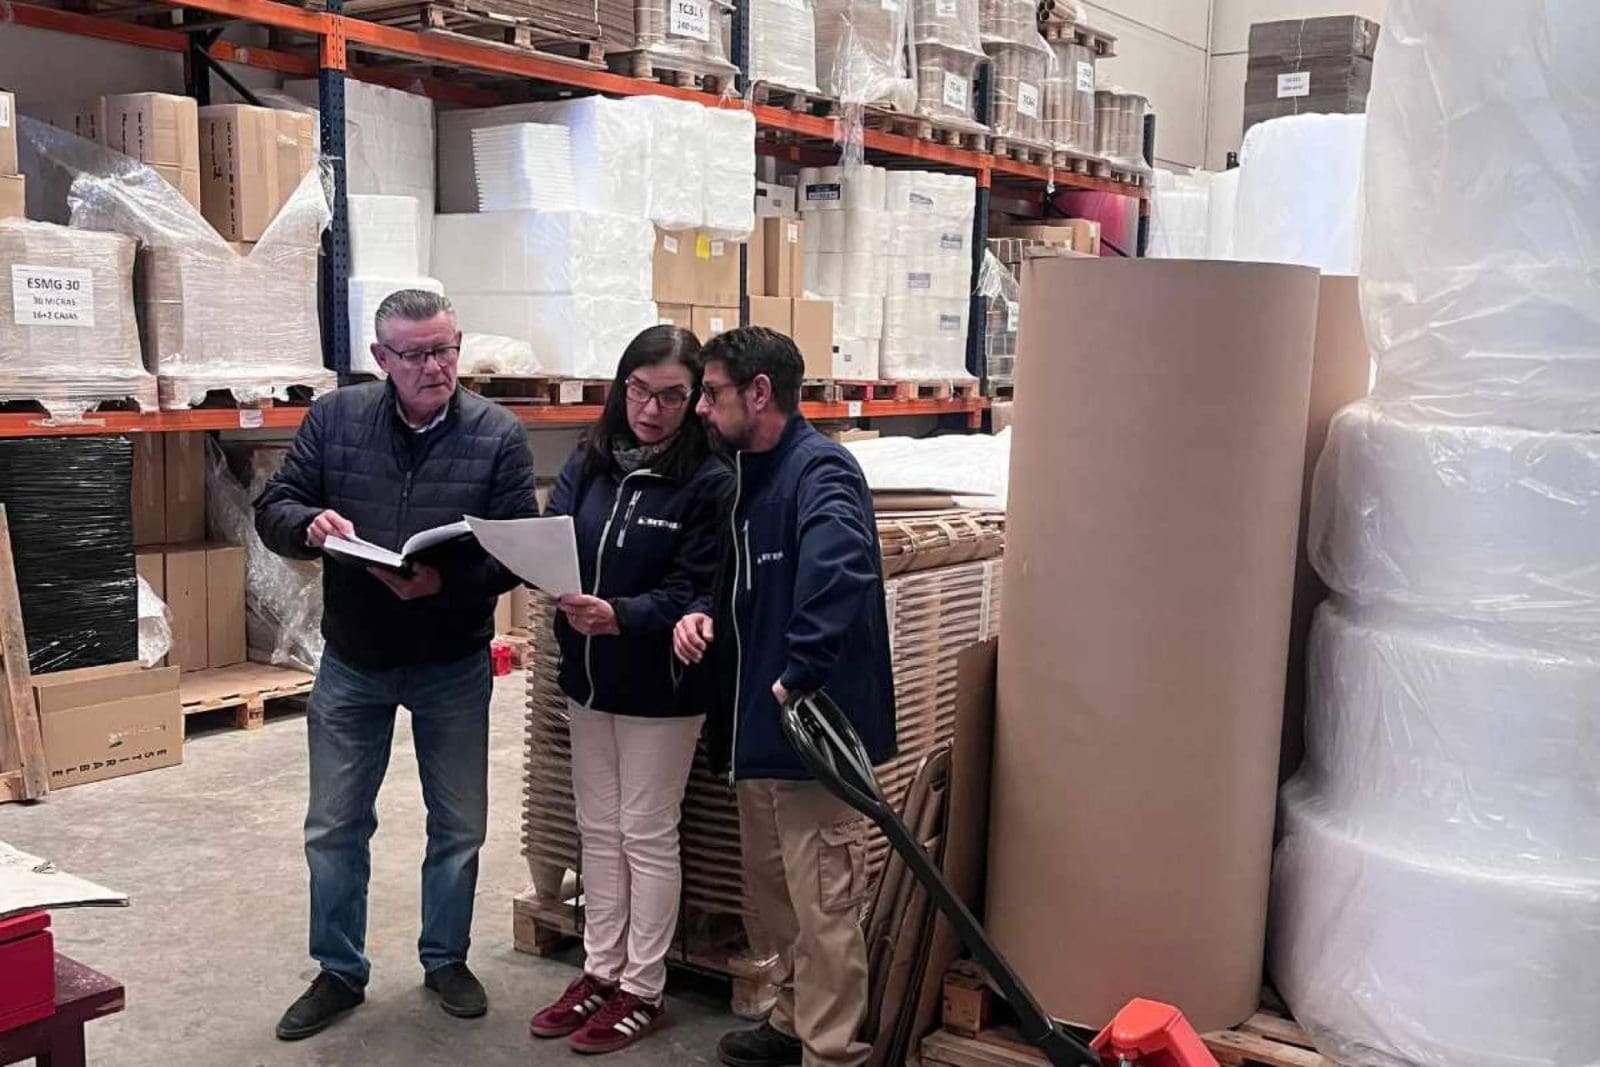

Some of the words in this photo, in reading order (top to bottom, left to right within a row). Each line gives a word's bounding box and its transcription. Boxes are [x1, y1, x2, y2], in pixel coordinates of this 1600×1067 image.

[27, 277, 63, 290] ESMG
[65, 279, 80, 291] 30
[45, 297, 76, 306] MICRAS
